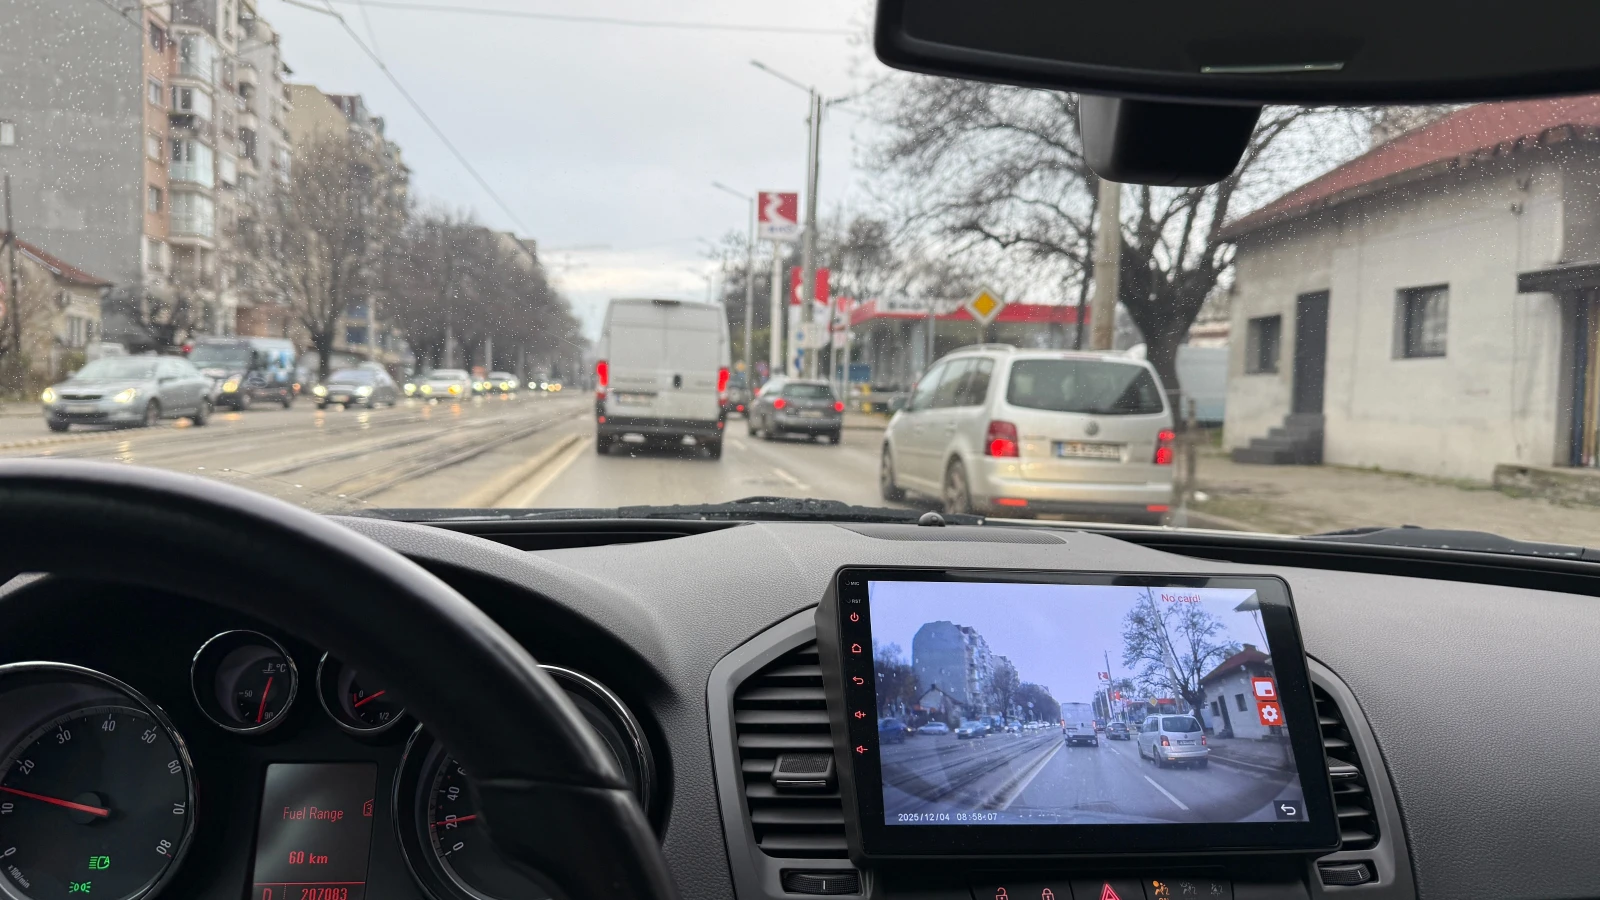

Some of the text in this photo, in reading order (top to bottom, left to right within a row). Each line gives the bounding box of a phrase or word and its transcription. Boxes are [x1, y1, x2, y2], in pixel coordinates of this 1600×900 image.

[1161, 593, 1201, 603] No card!
[244, 689, 253, 698] 50
[358, 690, 364, 699] 0
[379, 711, 390, 720] 1/2
[101, 720, 116, 732] 40
[56, 729, 72, 744] 30
[141, 729, 157, 744] 50
[19, 759, 35, 775] 20
[167, 759, 182, 774] 60
[447, 786, 460, 801] 40
[1, 802, 14, 815] 10
[172, 801, 186, 815] 70
[283, 806, 344, 822] Fuel Range
[445, 814, 458, 830] 20
[898, 812, 998, 821] 2025/12/04 08:58:07
[4, 846, 17, 856] 0
[156, 839, 172, 855] 80
[452, 841, 464, 851] 0
[288, 851, 329, 864] 60 km
[262, 887, 348, 900] D 207083
